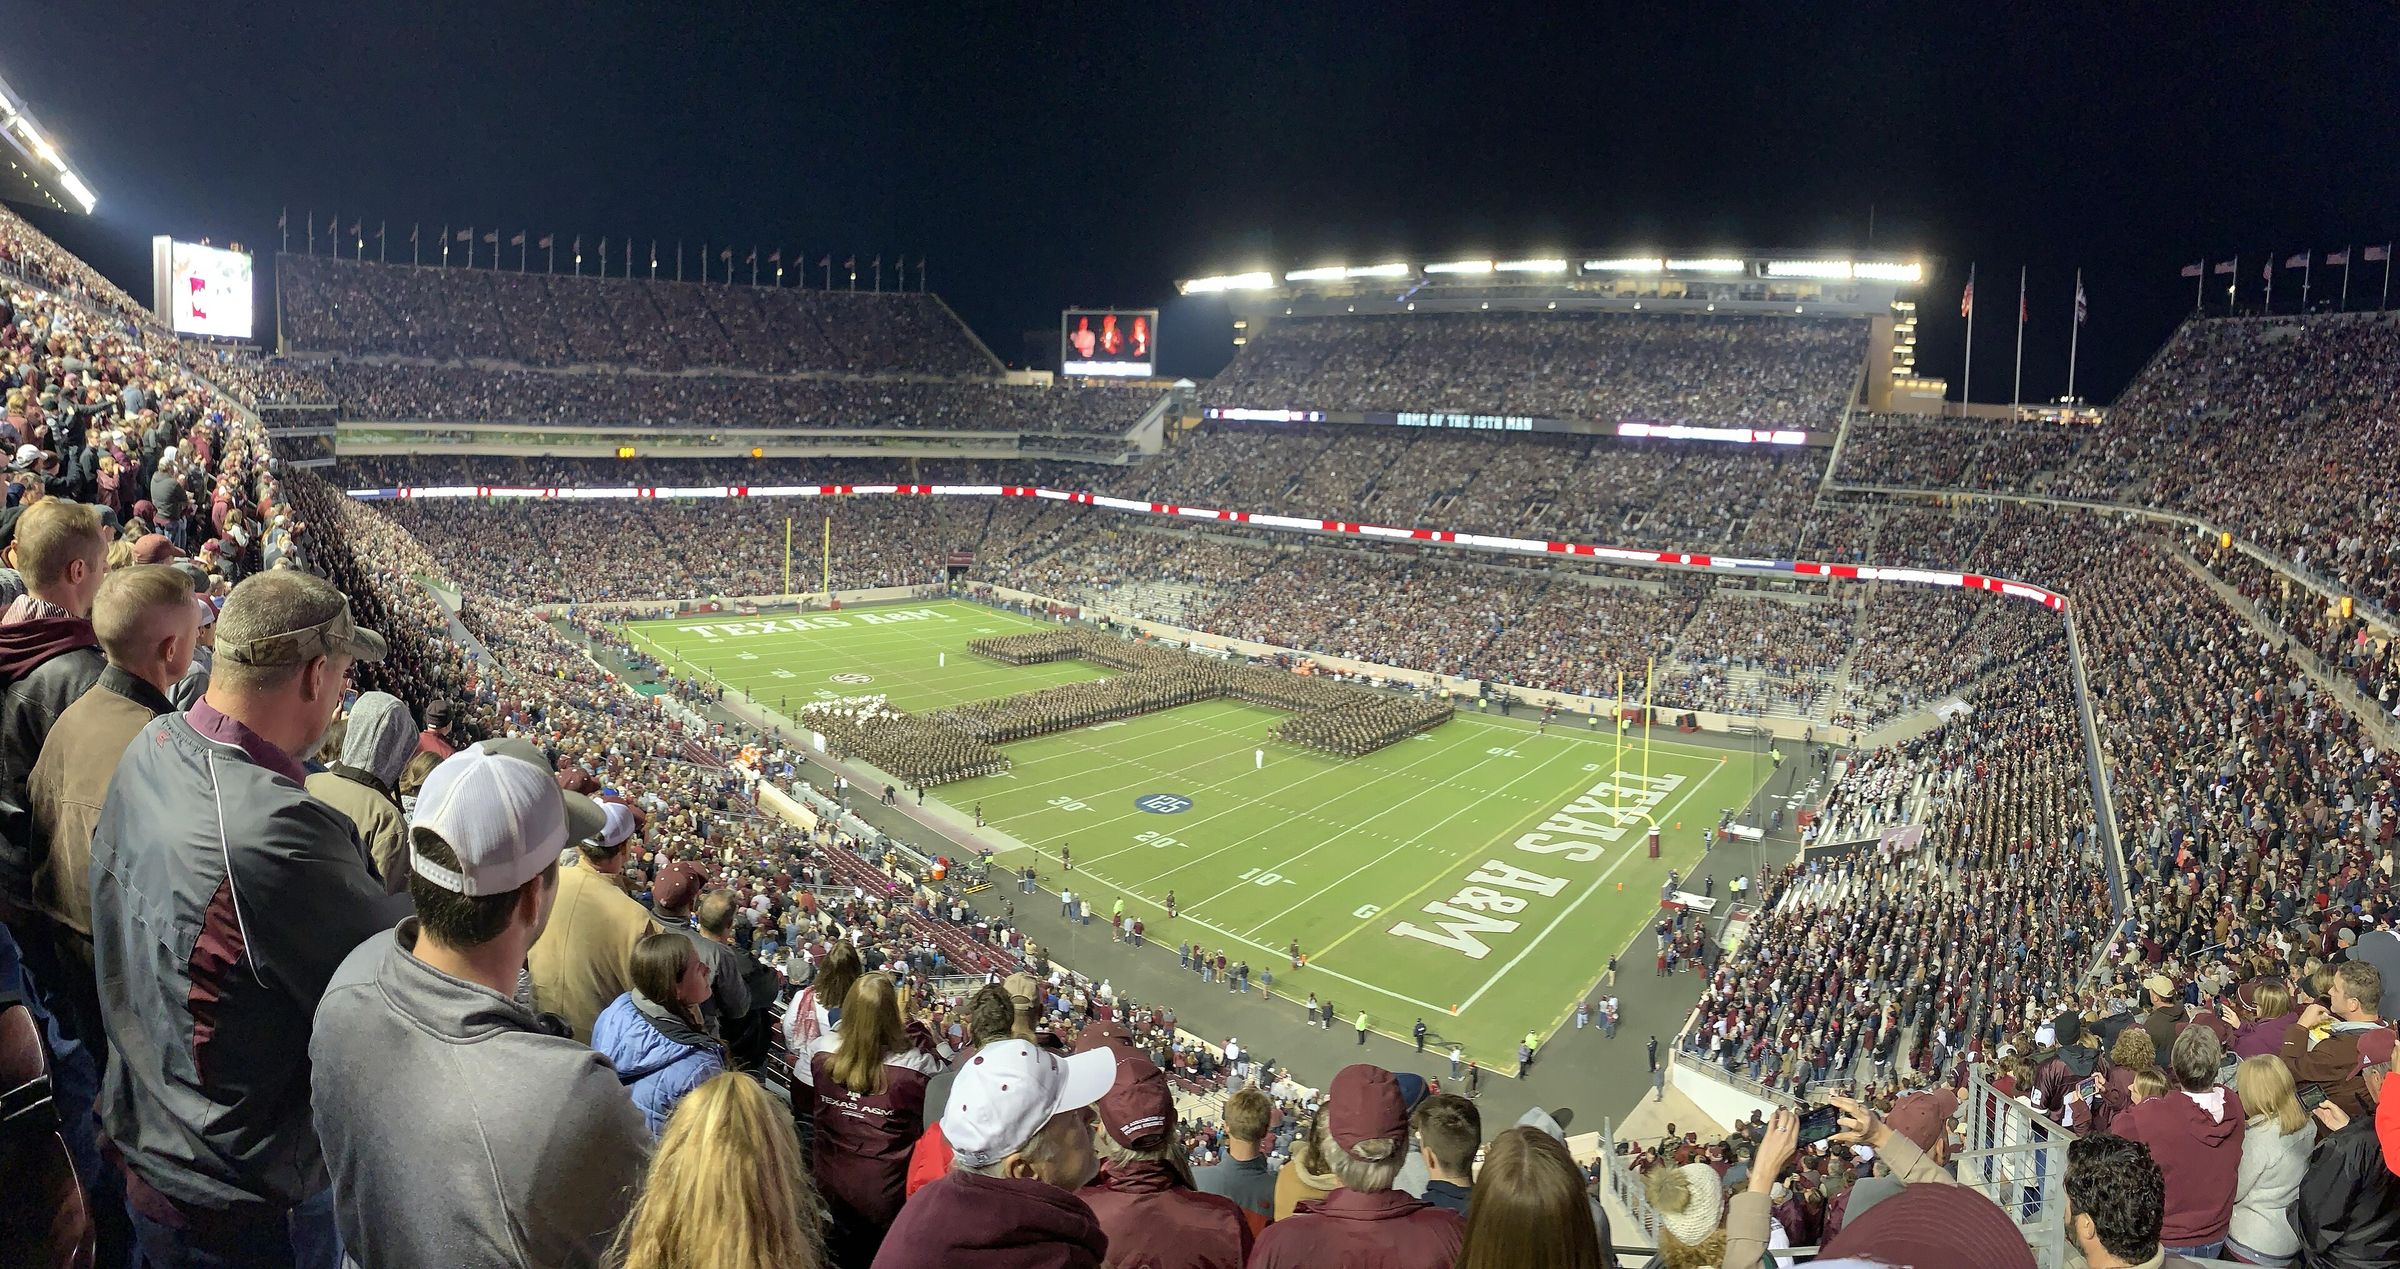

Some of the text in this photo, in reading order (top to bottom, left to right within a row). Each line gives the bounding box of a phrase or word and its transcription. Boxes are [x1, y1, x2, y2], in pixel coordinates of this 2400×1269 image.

[1397, 412, 1533, 431] HOME OF THE 12TH MAN
[677, 609, 950, 638] TEXAS A&M
[1048, 796, 1086, 812] 30
[1141, 795, 1192, 813] 125
[1134, 831, 1176, 848] 20
[1386, 771, 1687, 960] TEXAS A&M
[1238, 868, 1283, 886] 10
[1353, 904, 1382, 919] G
[820, 1094, 858, 1110] TEXAS
[860, 1105, 894, 1116] A&M
